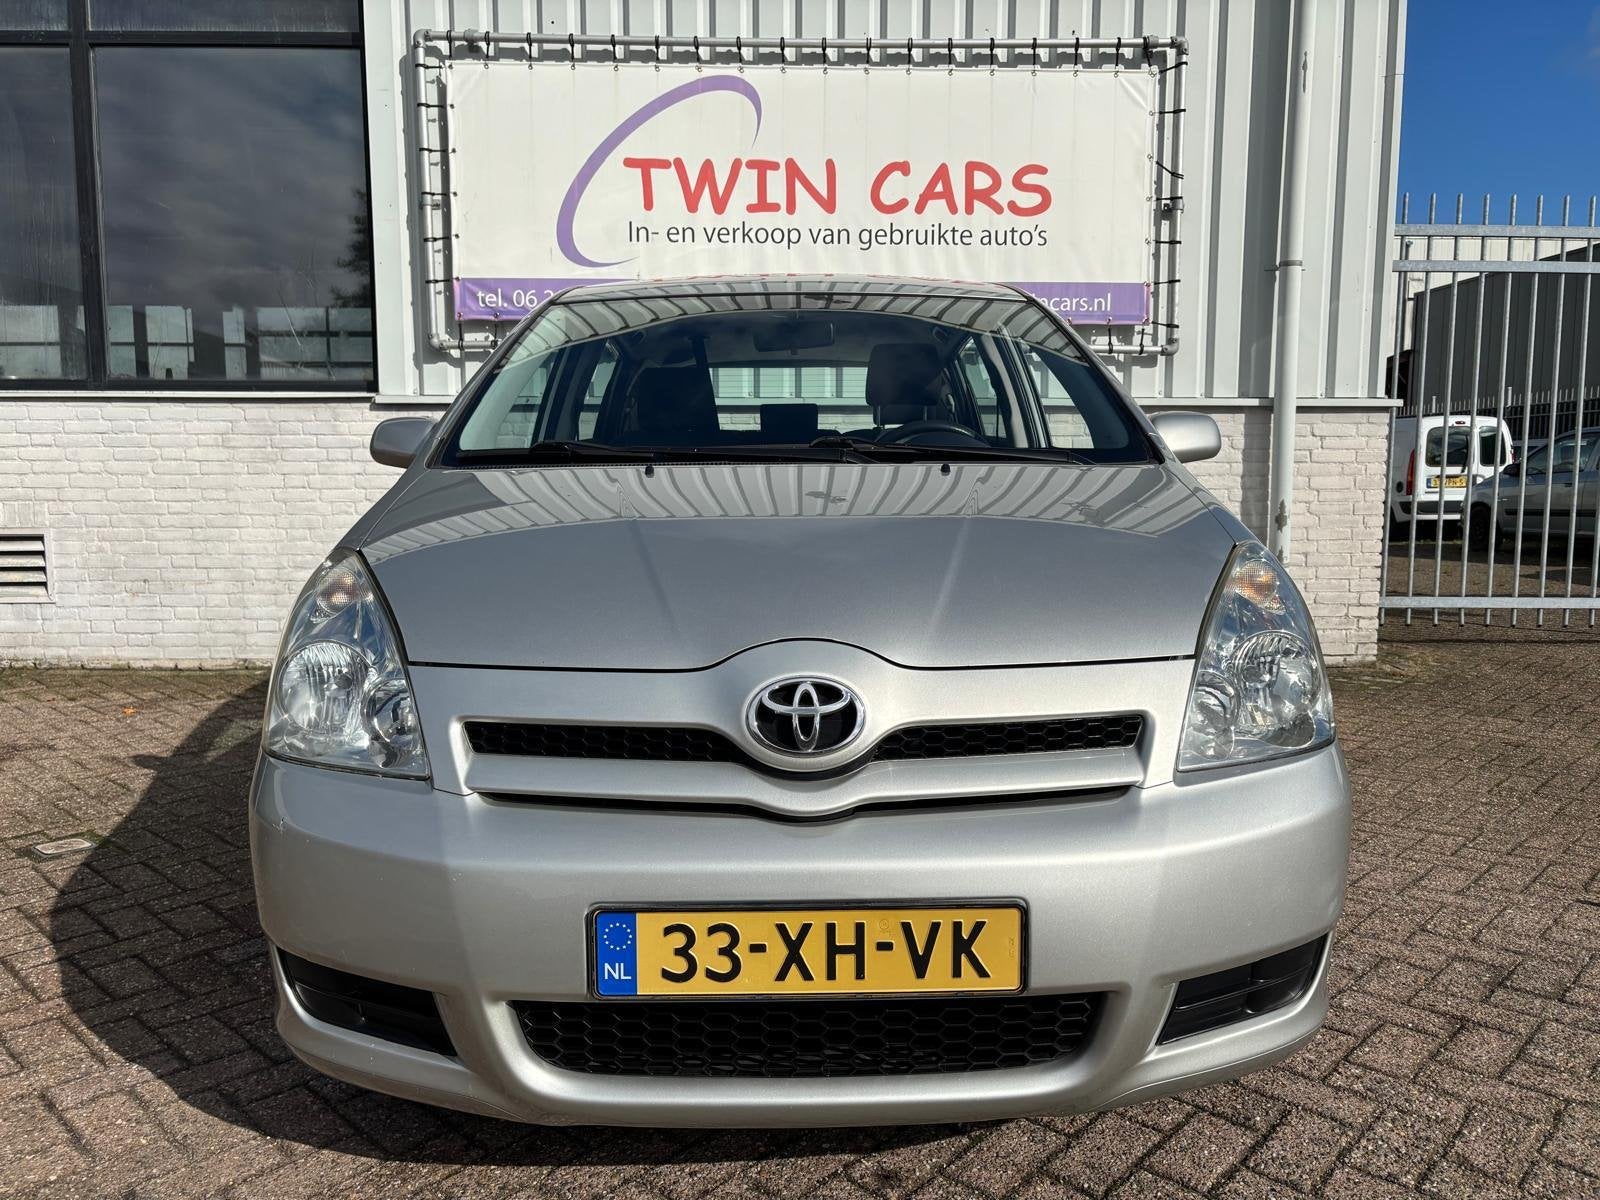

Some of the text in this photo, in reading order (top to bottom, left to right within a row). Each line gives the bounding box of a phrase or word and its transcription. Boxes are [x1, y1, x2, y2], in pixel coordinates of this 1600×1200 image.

[623, 157, 1052, 217] TWIN CARS
[628, 221, 1048, 251] In- en verkoop van gebruikte auto's
[476, 288, 508, 308] tel.
[512, 289, 538, 308] 06
[660, 921, 991, 983] 33-XH-VK
[604, 963, 632, 980] NL
